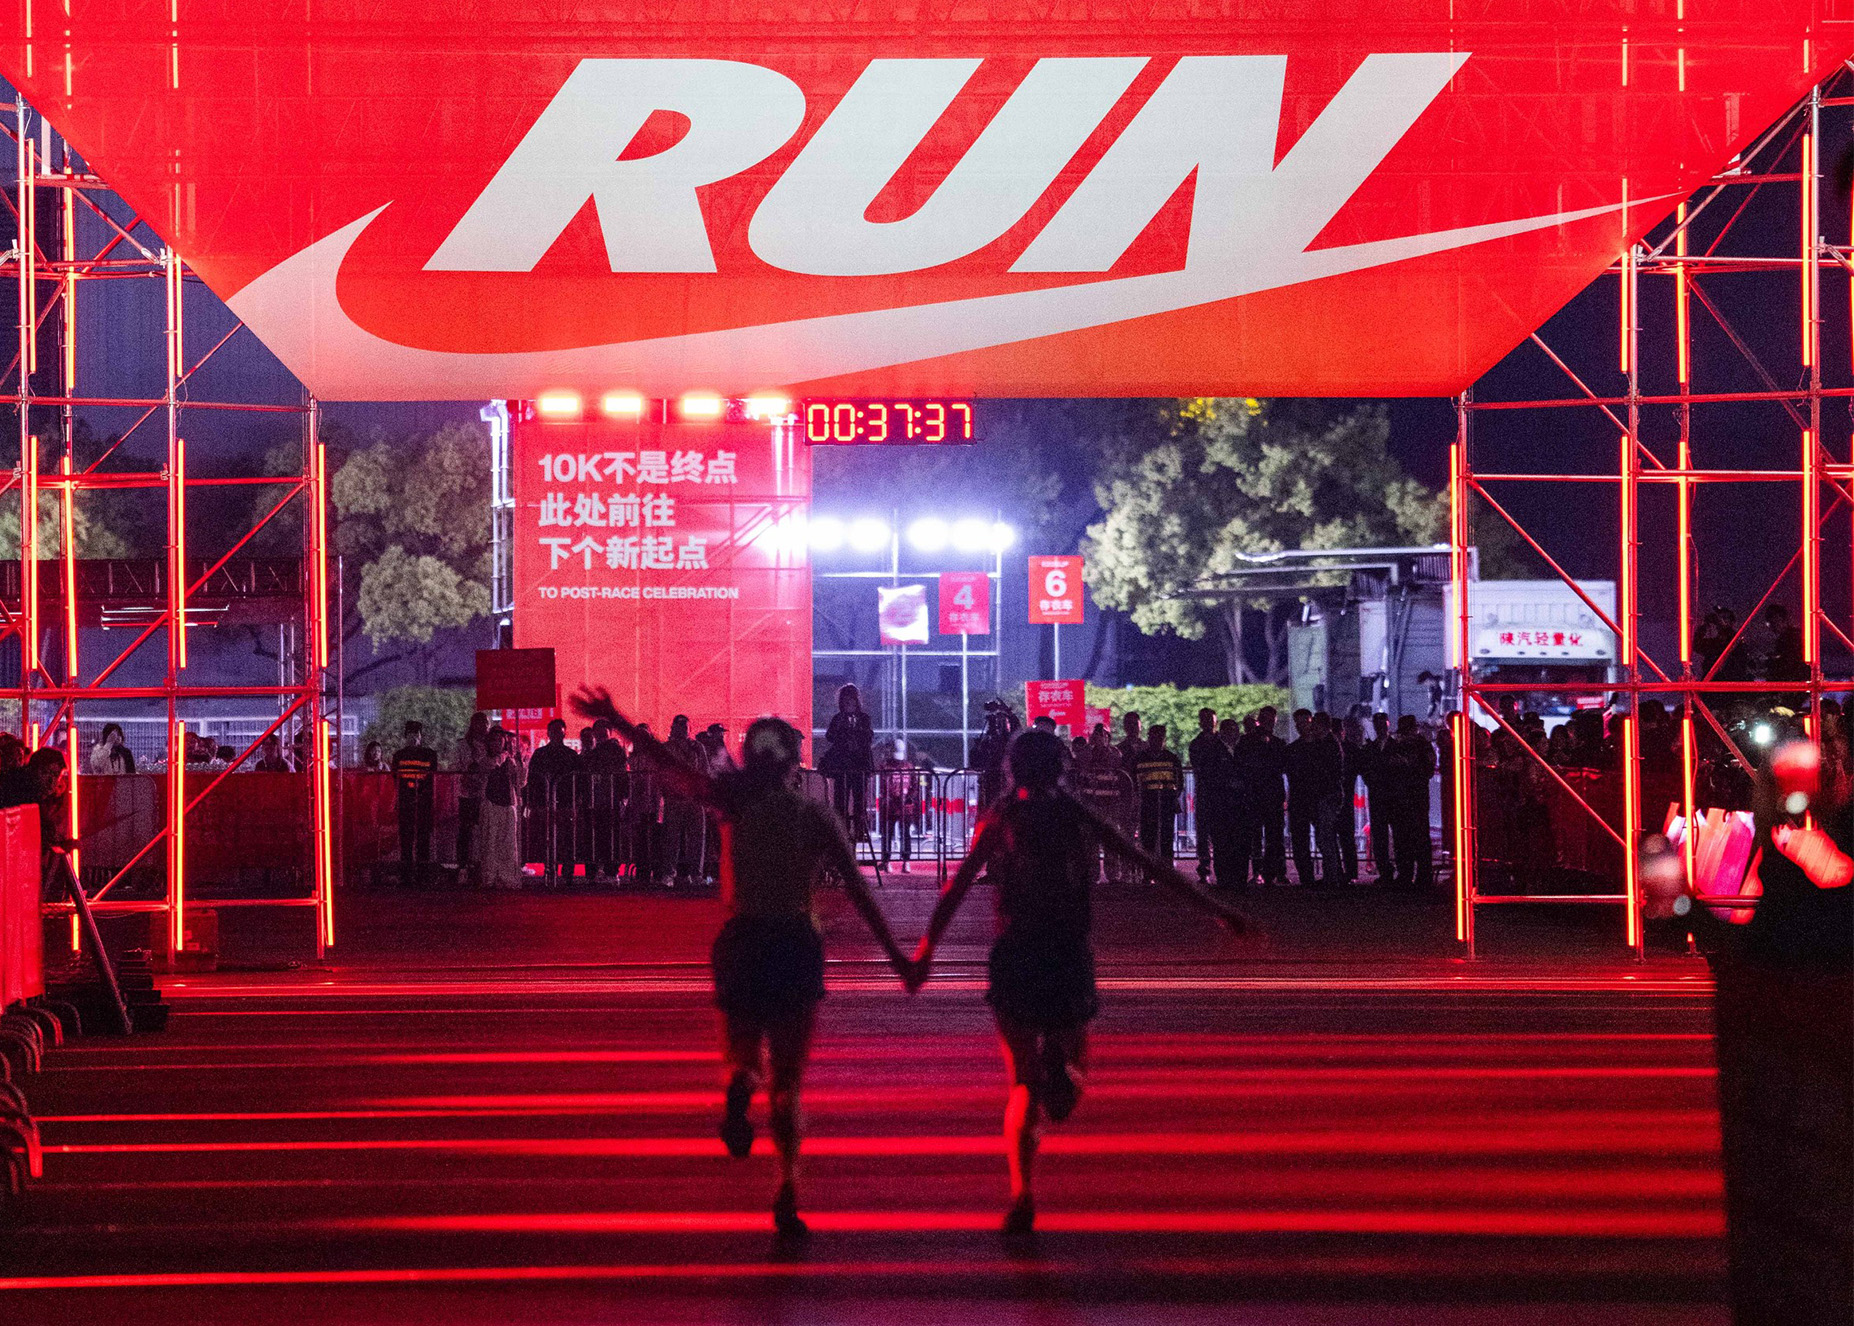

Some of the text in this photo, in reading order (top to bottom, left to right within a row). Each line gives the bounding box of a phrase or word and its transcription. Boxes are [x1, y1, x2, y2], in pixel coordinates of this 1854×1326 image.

[421, 52, 1471, 276] RUN
[807, 403, 971, 441] 00:37:37
[538, 450, 738, 484] 10K不是终点
[538, 492, 676, 527] 此处前往
[538, 535, 709, 570] 下个新起点
[538, 586, 739, 599] TO POST-RACE CELEBRATION
[953, 585, 974, 609] 4
[1045, 570, 1067, 597] 6
